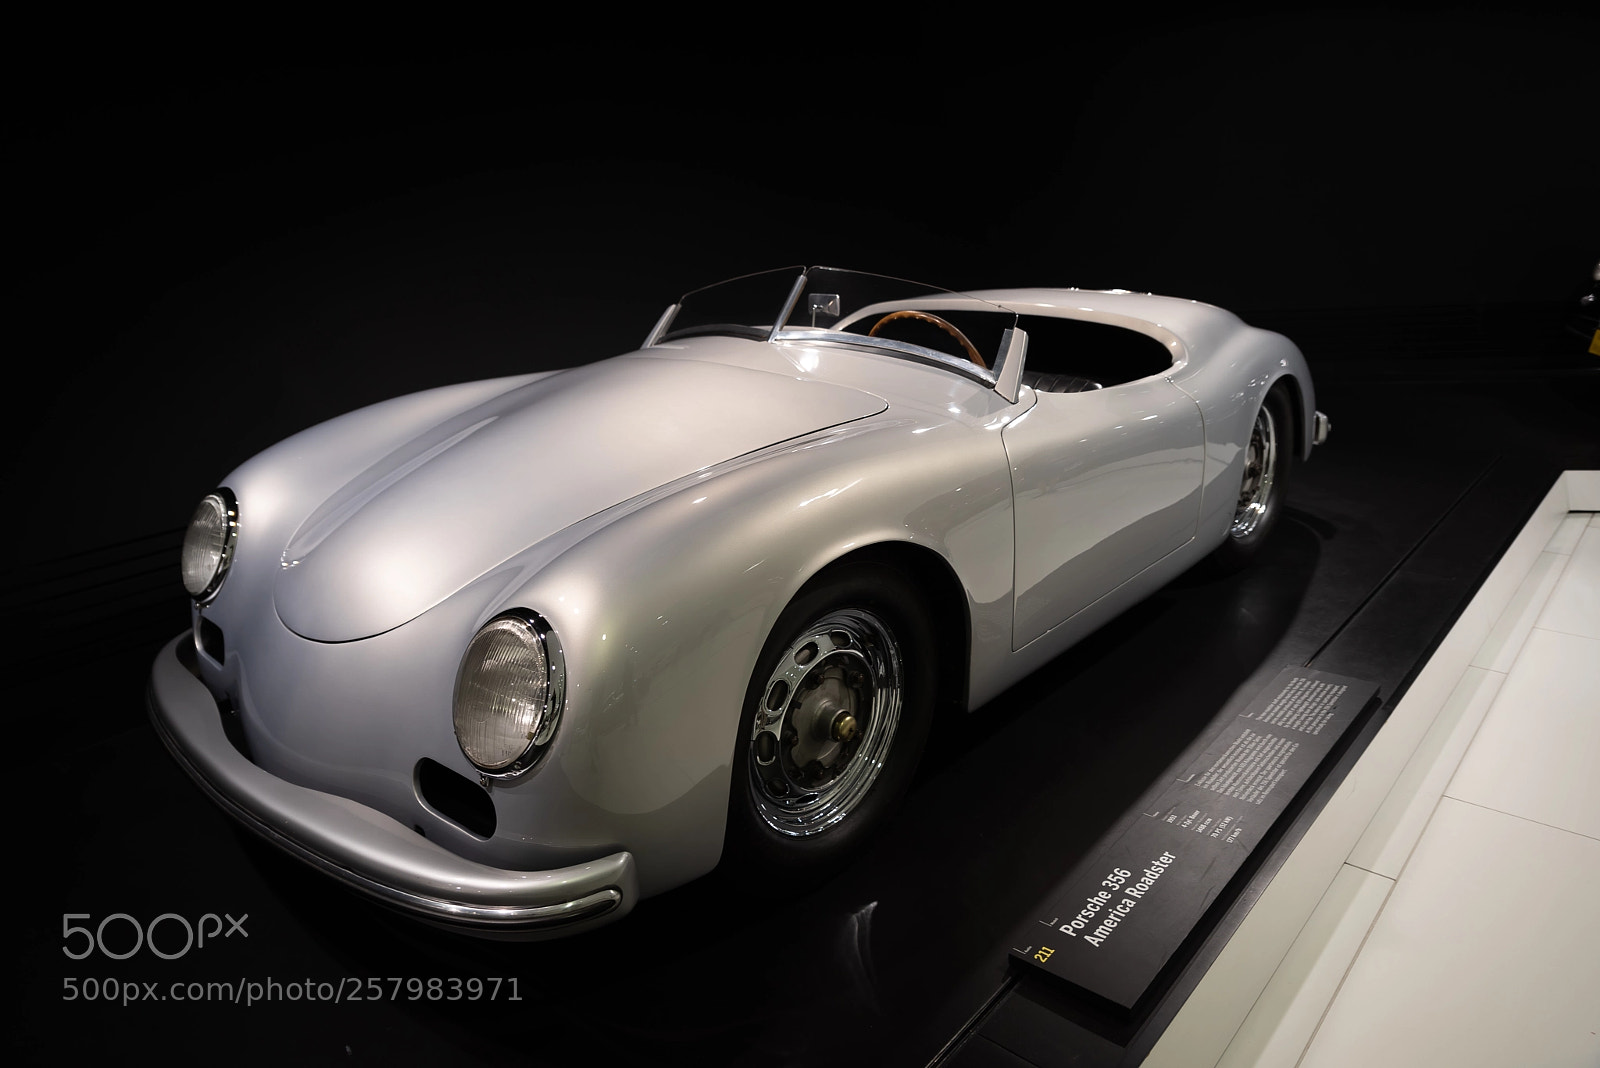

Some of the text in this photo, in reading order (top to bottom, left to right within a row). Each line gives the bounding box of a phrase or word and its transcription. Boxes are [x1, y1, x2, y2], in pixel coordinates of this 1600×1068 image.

[1059, 867, 1132, 937] Porsche 356
[1083, 850, 1176, 948] America Roadster
[1033, 946, 1056, 963] 211
